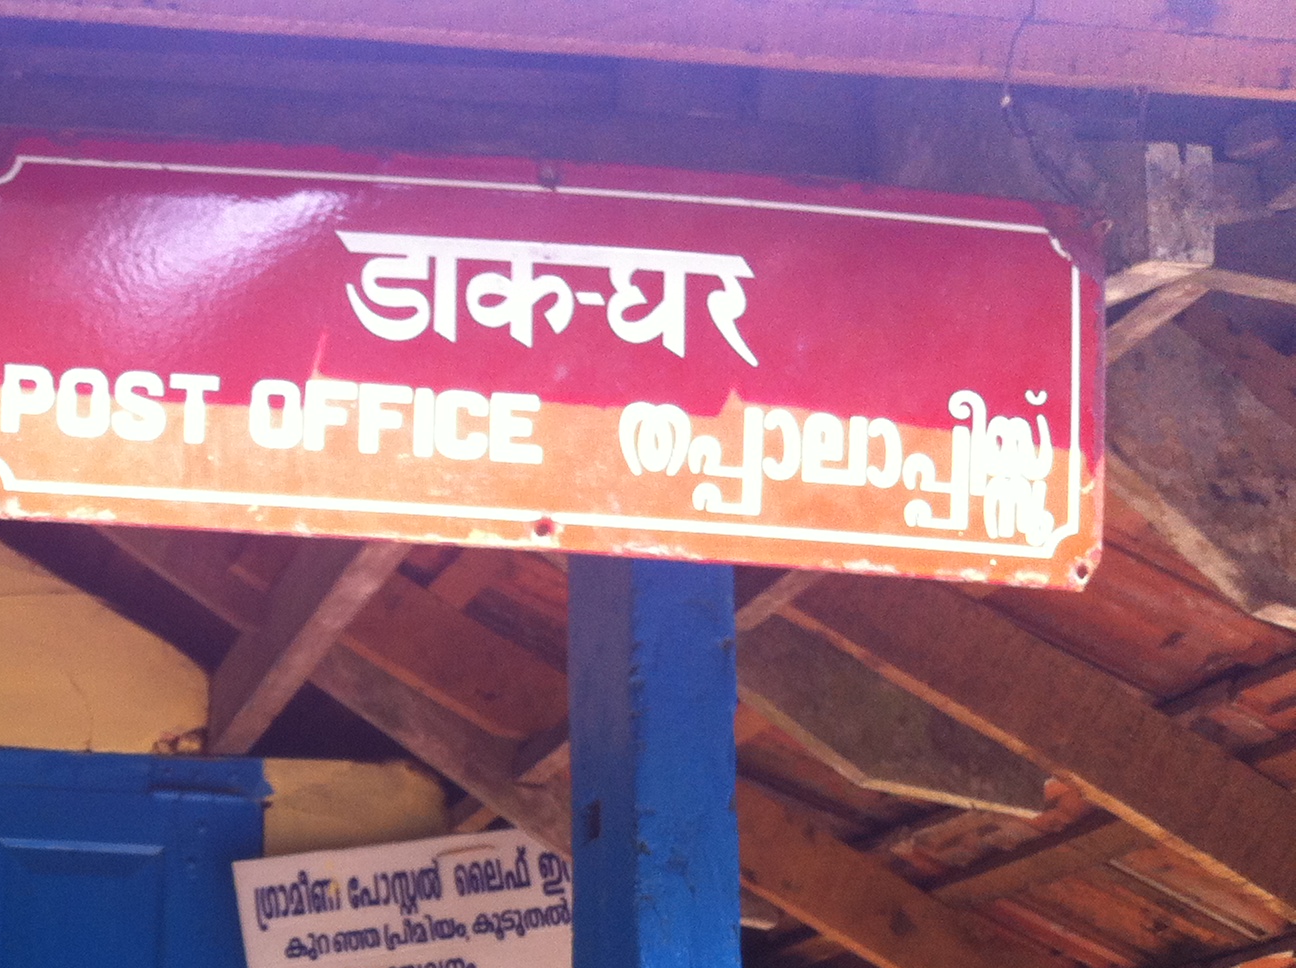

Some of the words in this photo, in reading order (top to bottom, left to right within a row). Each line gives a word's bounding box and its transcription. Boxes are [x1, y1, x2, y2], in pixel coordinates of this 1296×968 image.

[335, 230, 759, 367] डाक-घर
[0, 363, 220, 445] POST
[248, 379, 543, 465] OFFICE
